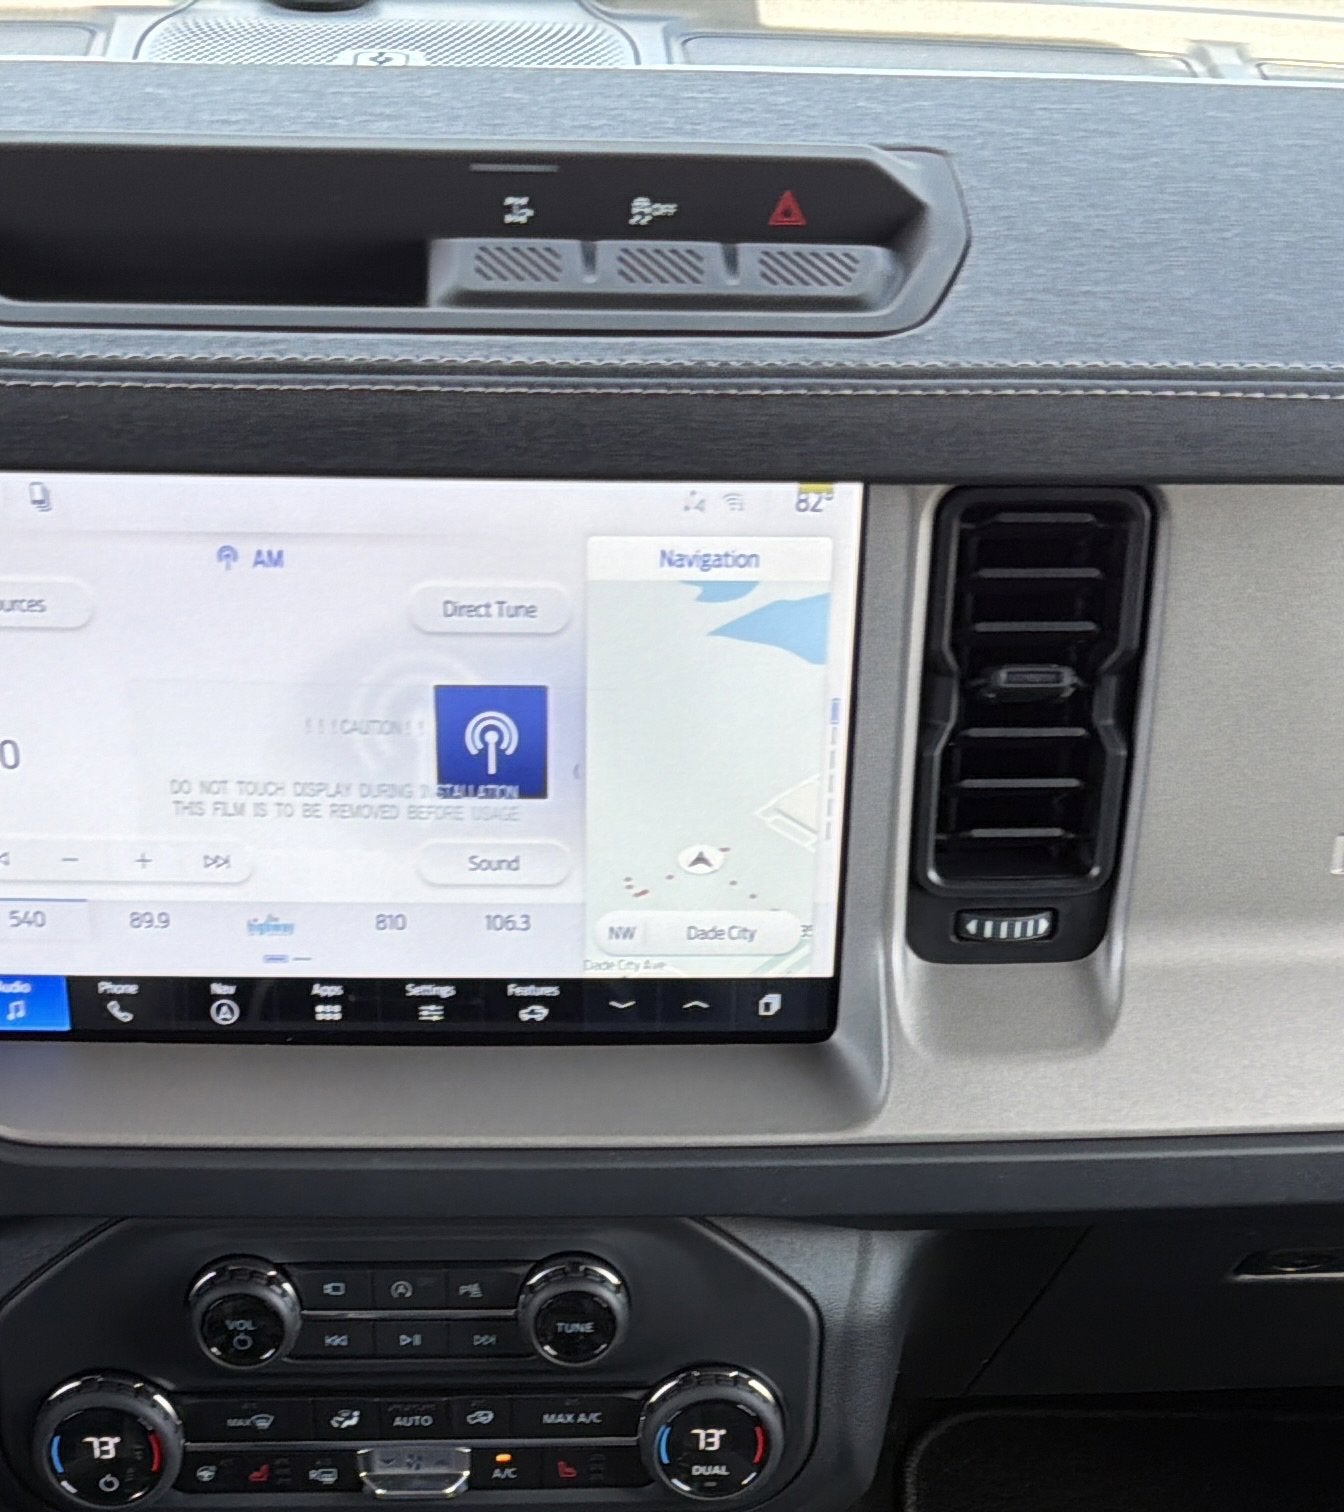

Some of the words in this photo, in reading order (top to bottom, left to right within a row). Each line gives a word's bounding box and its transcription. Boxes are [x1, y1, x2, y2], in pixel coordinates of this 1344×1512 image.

[251, 548, 286, 569] AM
[658, 548, 762, 572] Navigation
[441, 599, 494, 620] Direct
[494, 599, 539, 620] Tune
[169, 778, 192, 795] DO
[198, 779, 229, 796] NOT
[235, 779, 286, 797] TOUCH
[292, 781, 353, 798] DISPLAY
[171, 799, 205, 817] THIS
[212, 800, 247, 817] FILM
[252, 801, 269, 818] IS
[273, 801, 296, 818] TO
[301, 802, 322, 819] BE
[467, 855, 521, 873] Sound
[8, 909, 47, 929] 540
[129, 911, 171, 930] 89.9
[374, 913, 407, 931] 810
[484, 914, 532, 932] 106.3
[607, 925, 638, 941] NW
[685, 925, 726, 942] Dade
[727, 925, 758, 944] City
[97, 981, 140, 996] Phone
[209, 982, 238, 997] Nav
[310, 983, 346, 999] Apps
[404, 982, 457, 999] Settings
[506, 983, 561, 999] Features
[224, 1319, 257, 1332] VOL
[555, 1322, 596, 1335] TUNE
[392, 1414, 434, 1428] AUTO
[542, 1412, 574, 1426] MAX
[576, 1411, 604, 1426] A/C
[491, 1466, 519, 1481] A/C
[690, 1463, 731, 1477] DUAL
